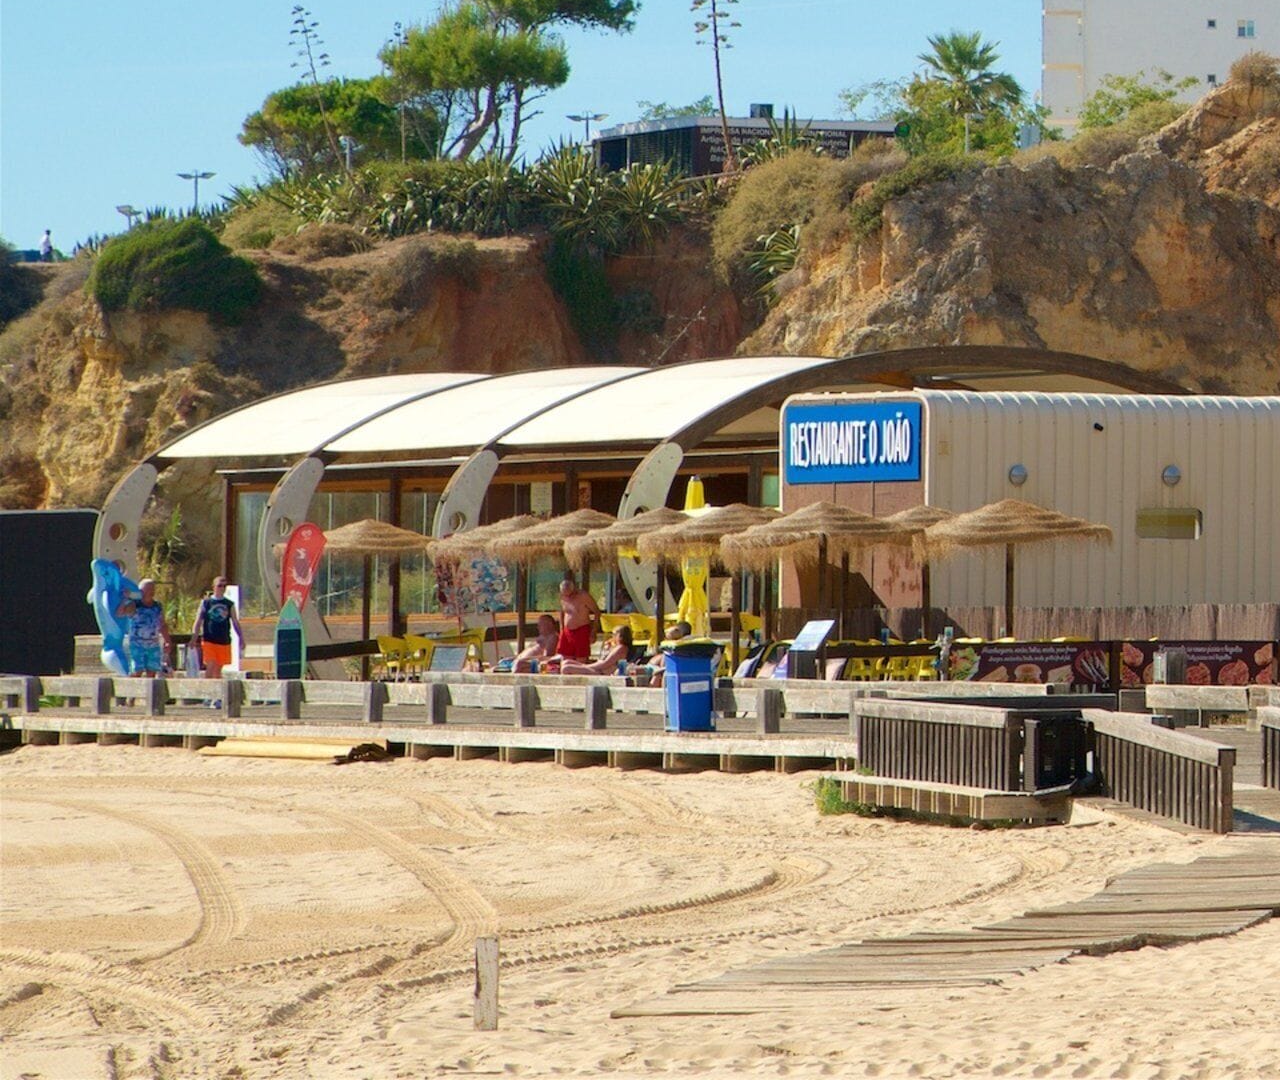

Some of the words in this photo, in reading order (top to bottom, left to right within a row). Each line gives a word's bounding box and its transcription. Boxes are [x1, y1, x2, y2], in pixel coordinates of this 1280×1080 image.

[790, 420, 866, 467] RESTAURANTE
[869, 420, 878, 464] O
[880, 411, 911, 464] JOÃO
